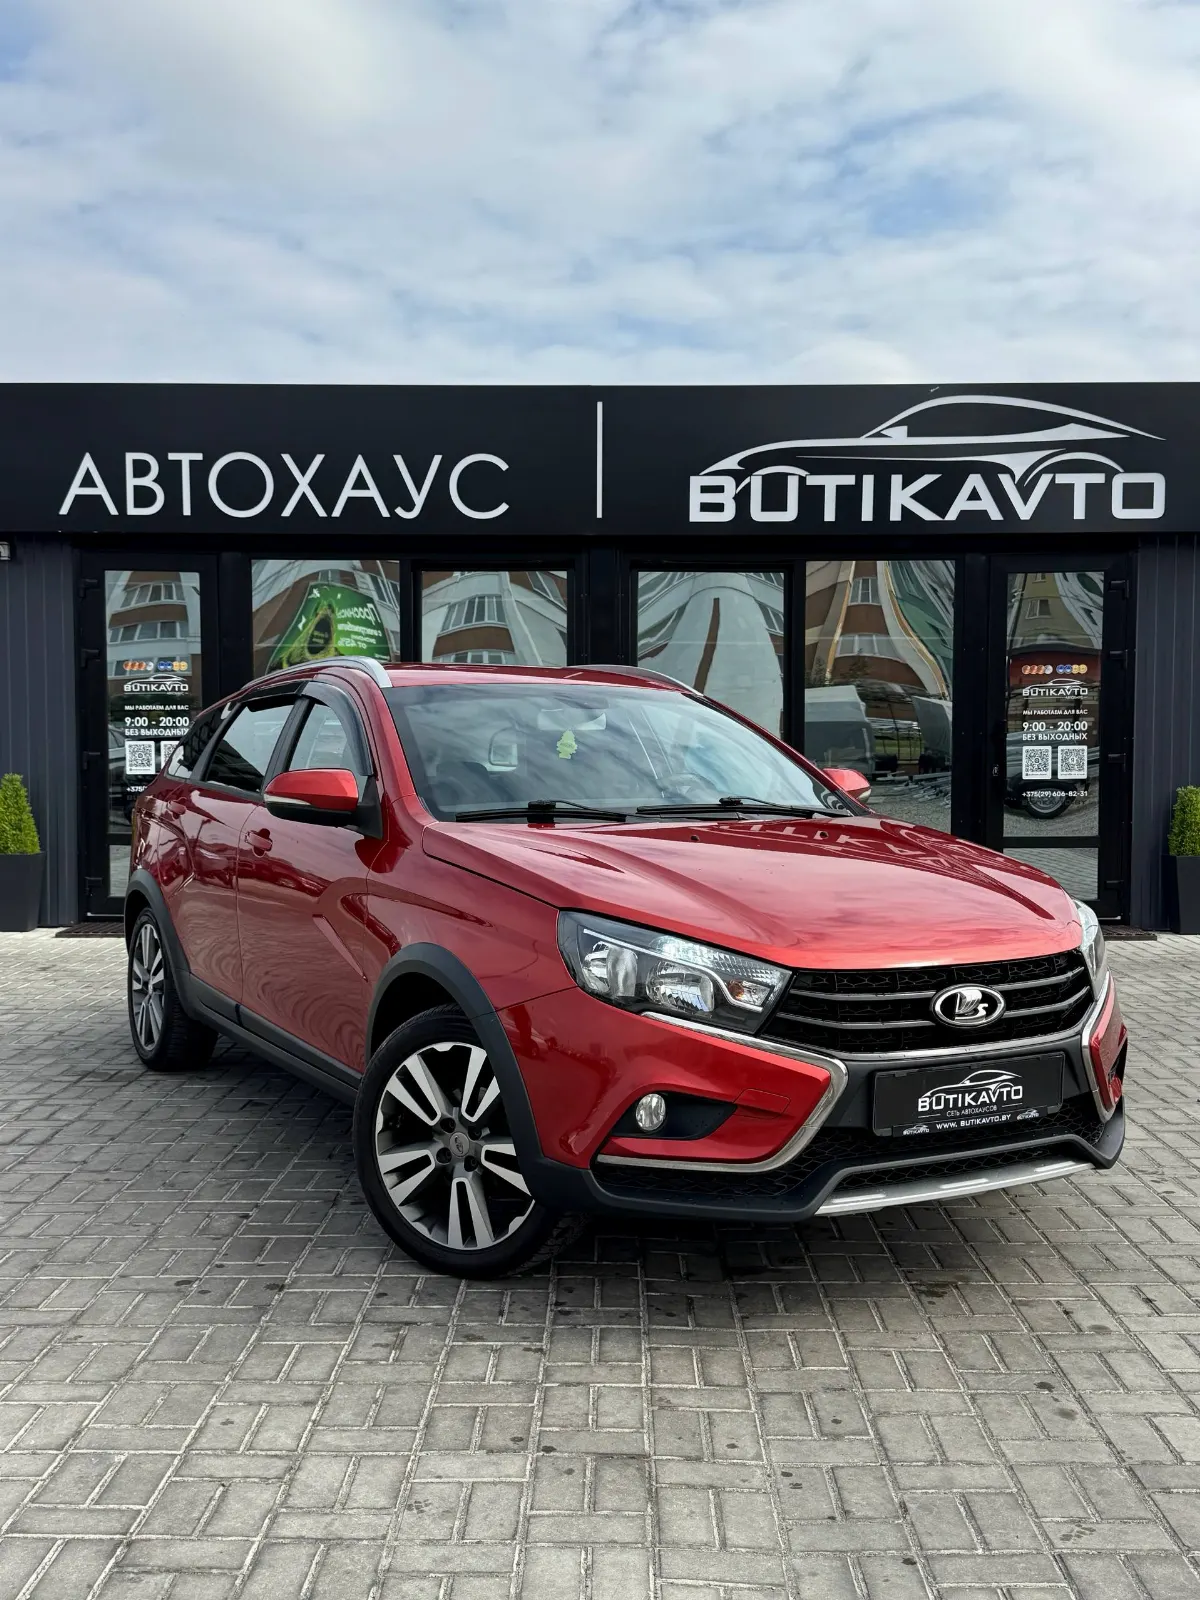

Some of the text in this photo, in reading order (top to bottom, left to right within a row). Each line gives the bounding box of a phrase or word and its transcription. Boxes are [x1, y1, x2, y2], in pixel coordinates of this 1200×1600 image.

[59, 451, 510, 519] АВТОХАУС
[689, 472, 1166, 523] BUTIKAVTO
[124, 683, 189, 692] BUTIKAVTO
[1022, 688, 1088, 696] BUTIKAVTO
[125, 717, 148, 726] 9:00
[159, 717, 189, 726] 20:00
[1023, 722, 1046, 731] 9:00
[1057, 721, 1088, 731] 20:00
[918, 1085, 1023, 1112] BUTIKAVTO
[961, 1105, 997, 1116] АВТОХАУСОВ
[936, 1114, 1011, 1130] WWW. BUTIKAVTO.BY
